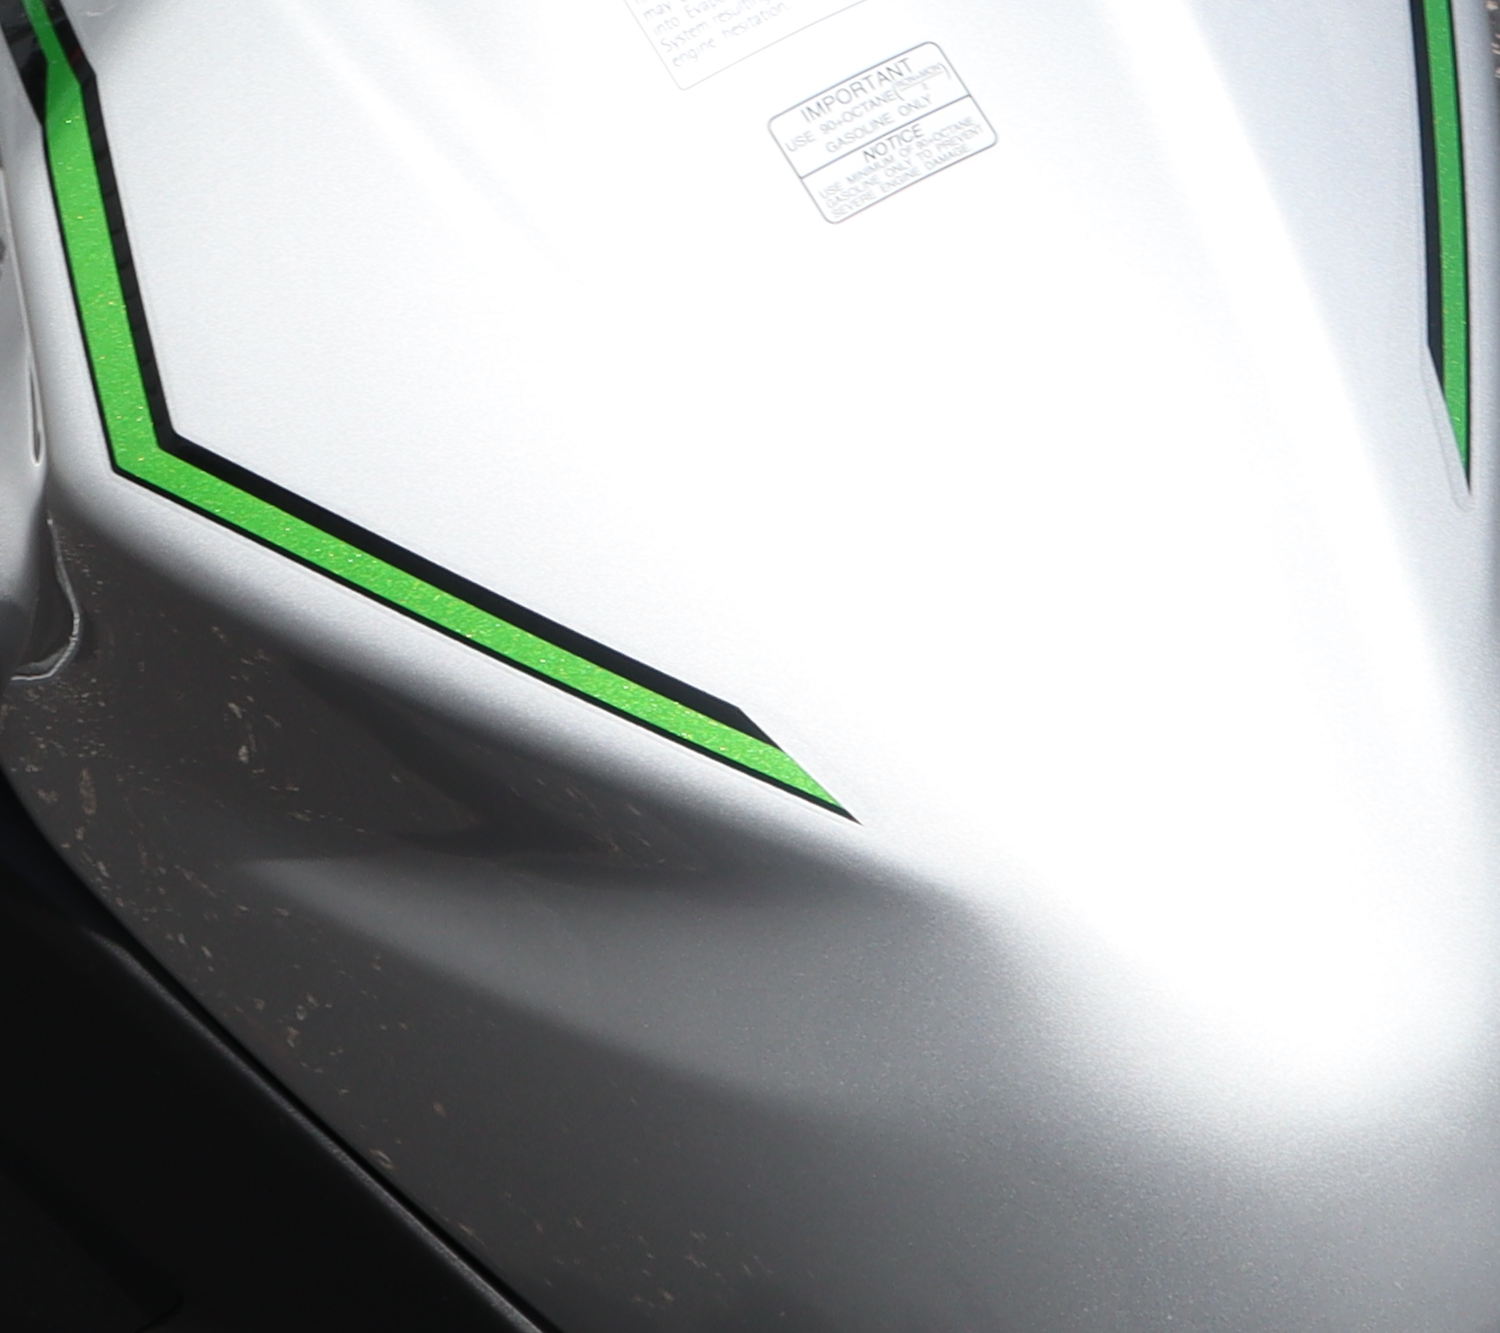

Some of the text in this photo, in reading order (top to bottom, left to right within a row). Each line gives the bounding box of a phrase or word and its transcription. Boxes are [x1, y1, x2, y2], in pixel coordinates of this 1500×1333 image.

[643, 1, 672, 22] may
[651, 16, 681, 37] into
[660, 20, 711, 53] System
[671, 38, 717, 68] engine
[800, 57, 913, 123] IMPORTANT
[785, 130, 816, 153] USE
[824, 93, 933, 154] GASOLINE ONLY
[862, 124, 924, 163] NOTICE
[819, 179, 843, 199] USE
[846, 154, 895, 183] MINIMUM
[900, 143, 914, 158] OF
[825, 124, 984, 209] GASOLINE ONLY TO PREVENT
[831, 191, 876, 219] SEVERE
[880, 167, 921, 193] ENGINE
